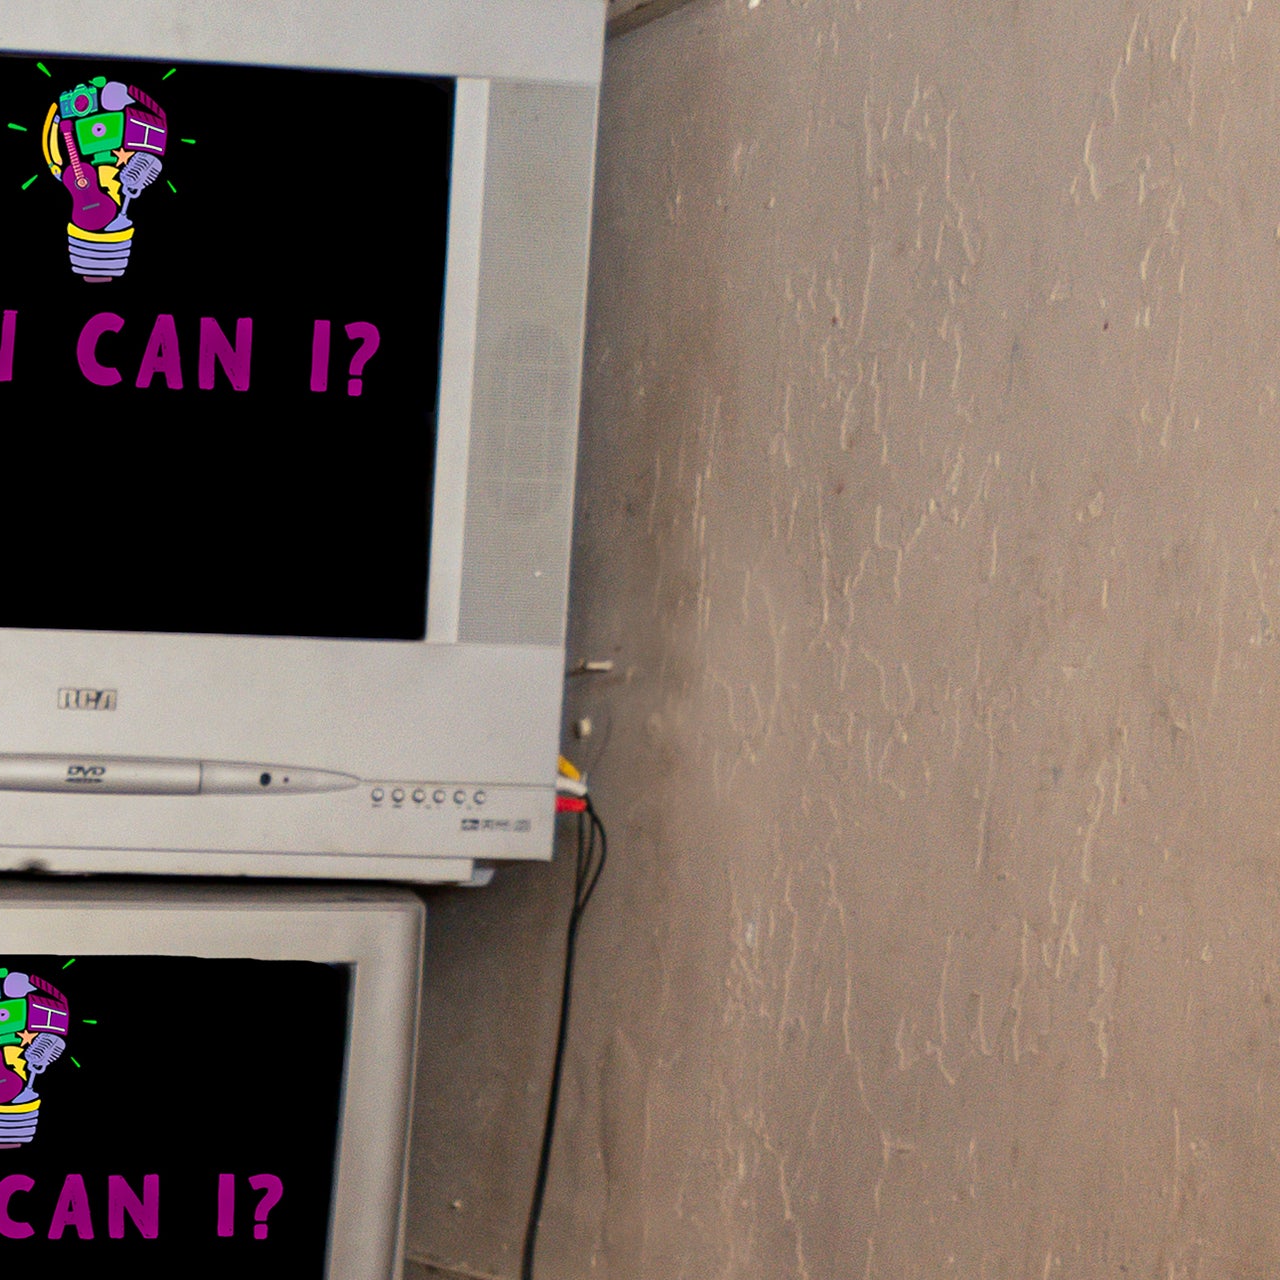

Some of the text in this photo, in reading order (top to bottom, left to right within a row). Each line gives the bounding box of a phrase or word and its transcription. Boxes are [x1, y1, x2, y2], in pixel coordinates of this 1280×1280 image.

[77, 313, 253, 392] CAN
[311, 319, 381, 397] I?
[57, 687, 118, 712] RCA
[67, 765, 107, 778] DVD
[217, 1173, 284, 1240] I?
